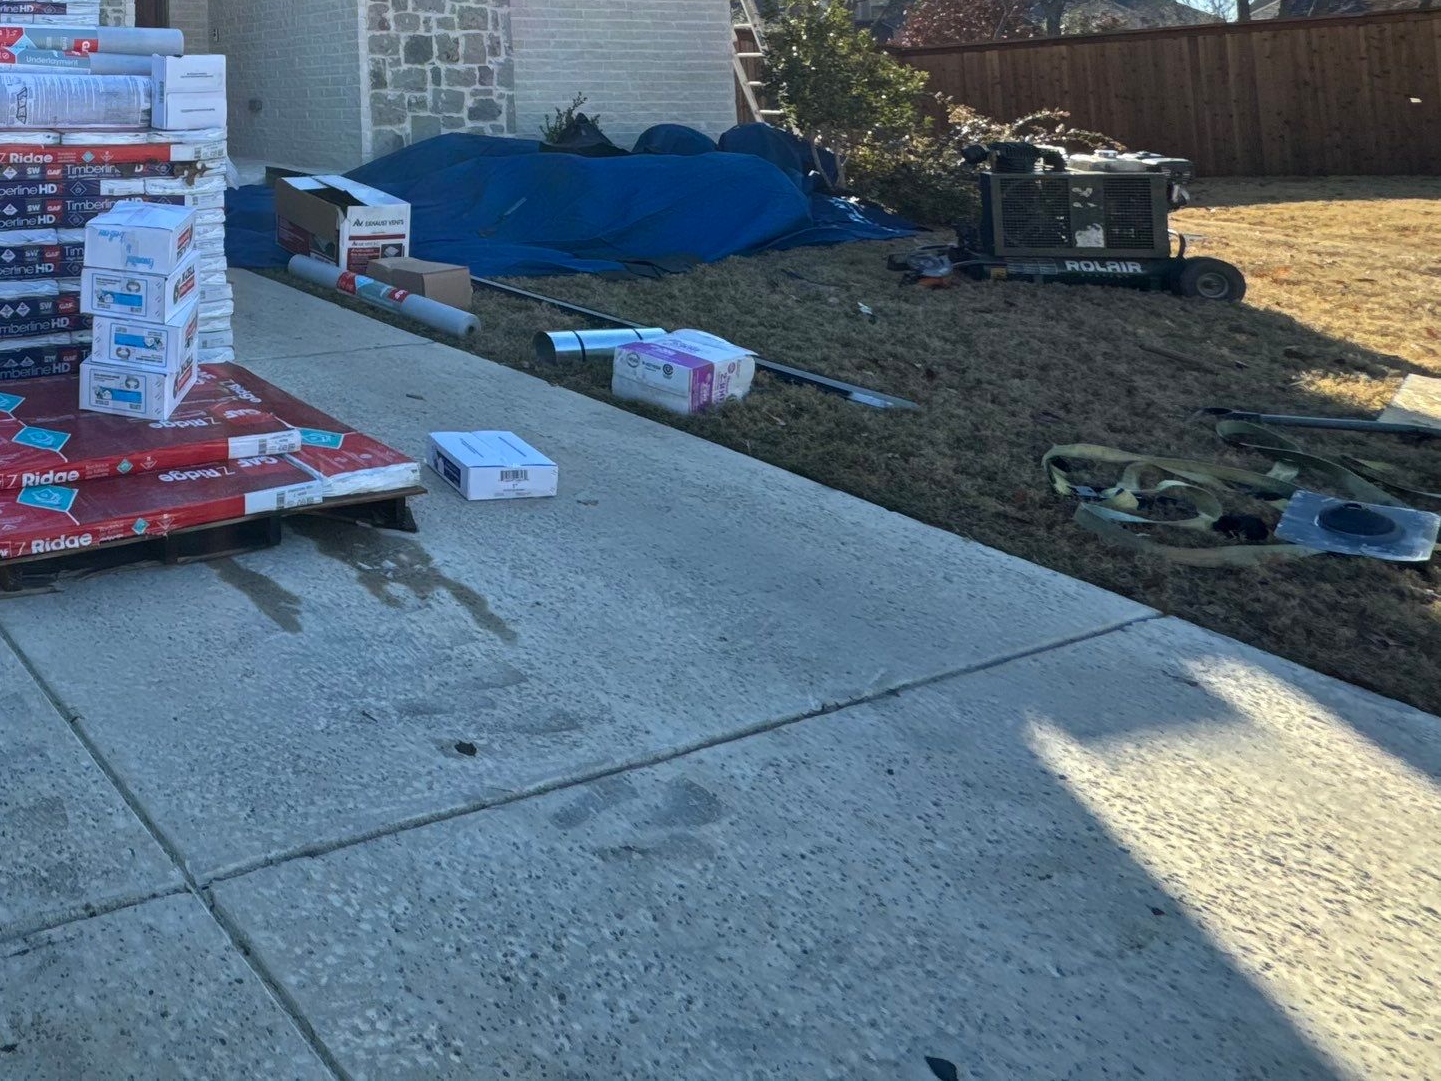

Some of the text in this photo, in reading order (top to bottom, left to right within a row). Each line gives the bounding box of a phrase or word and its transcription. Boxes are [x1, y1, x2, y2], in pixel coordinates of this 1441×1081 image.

[20, 5, 34, 13] HD
[25, 55, 79, 66] Underlayment
[9, 152, 54, 164] Ridge
[26, 167, 41, 175] SW
[66, 163, 121, 175] Timberlin
[39, 183, 58, 194] HD
[66, 199, 116, 210] Timberlin
[38, 214, 56, 224] HD
[35, 262, 55, 273] HD
[1065, 260, 1142, 273] ROLAIR
[51, 317, 70, 328] HD
[52, 362, 71, 374] HD
[148, 418, 209, 429] Ridge
[21, 469, 80, 488] Ridge
[158, 468, 223, 482] Ridge
[31, 532, 93, 554] Ridge
